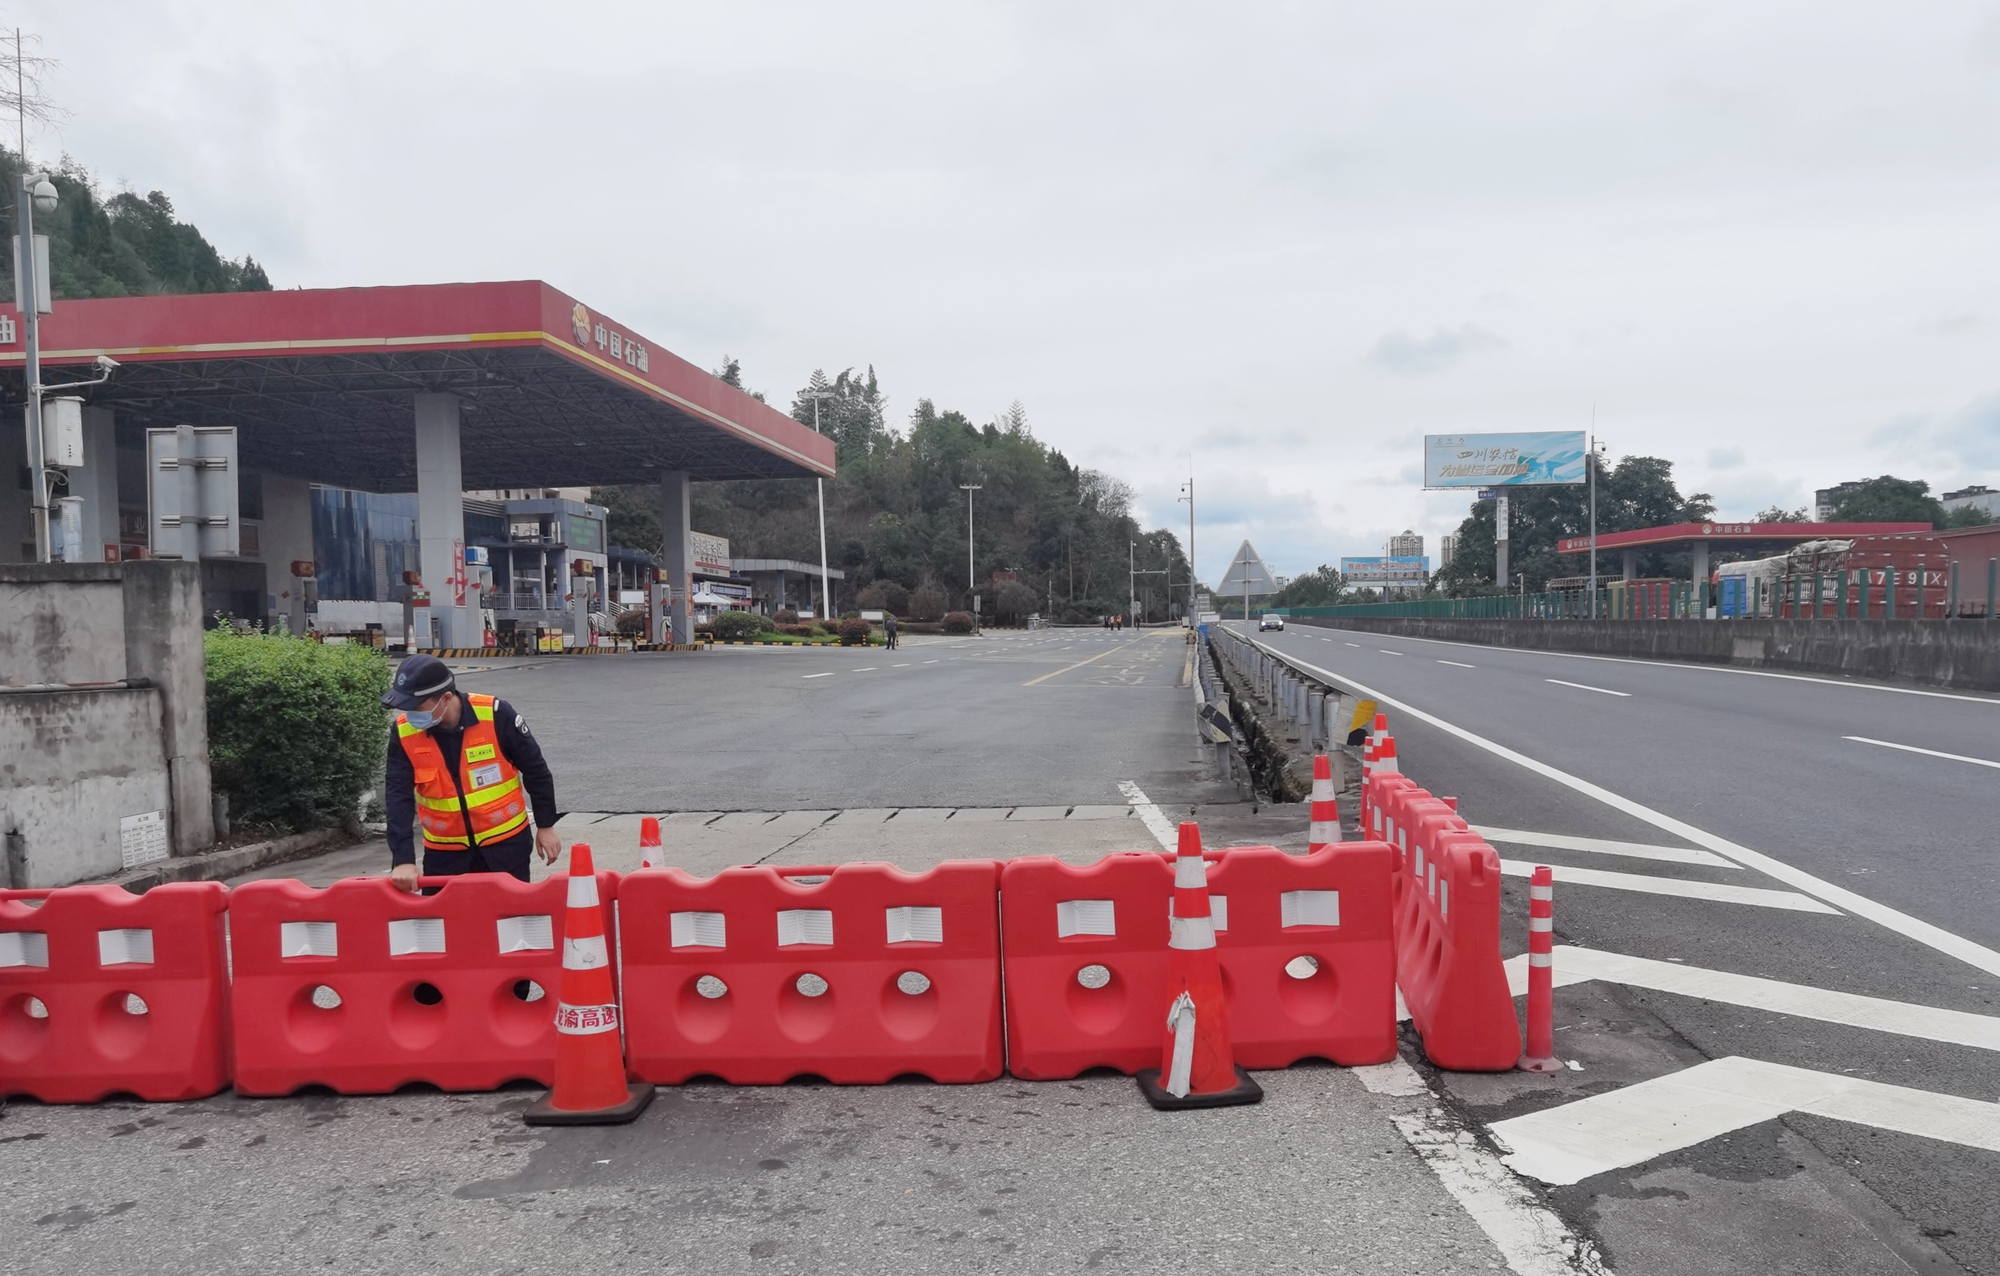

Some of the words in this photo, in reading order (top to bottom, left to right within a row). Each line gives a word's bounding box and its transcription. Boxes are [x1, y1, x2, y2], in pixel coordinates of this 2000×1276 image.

[594, 322, 649, 373] 中国石油
[1715, 525, 1751, 534] 中国石油
